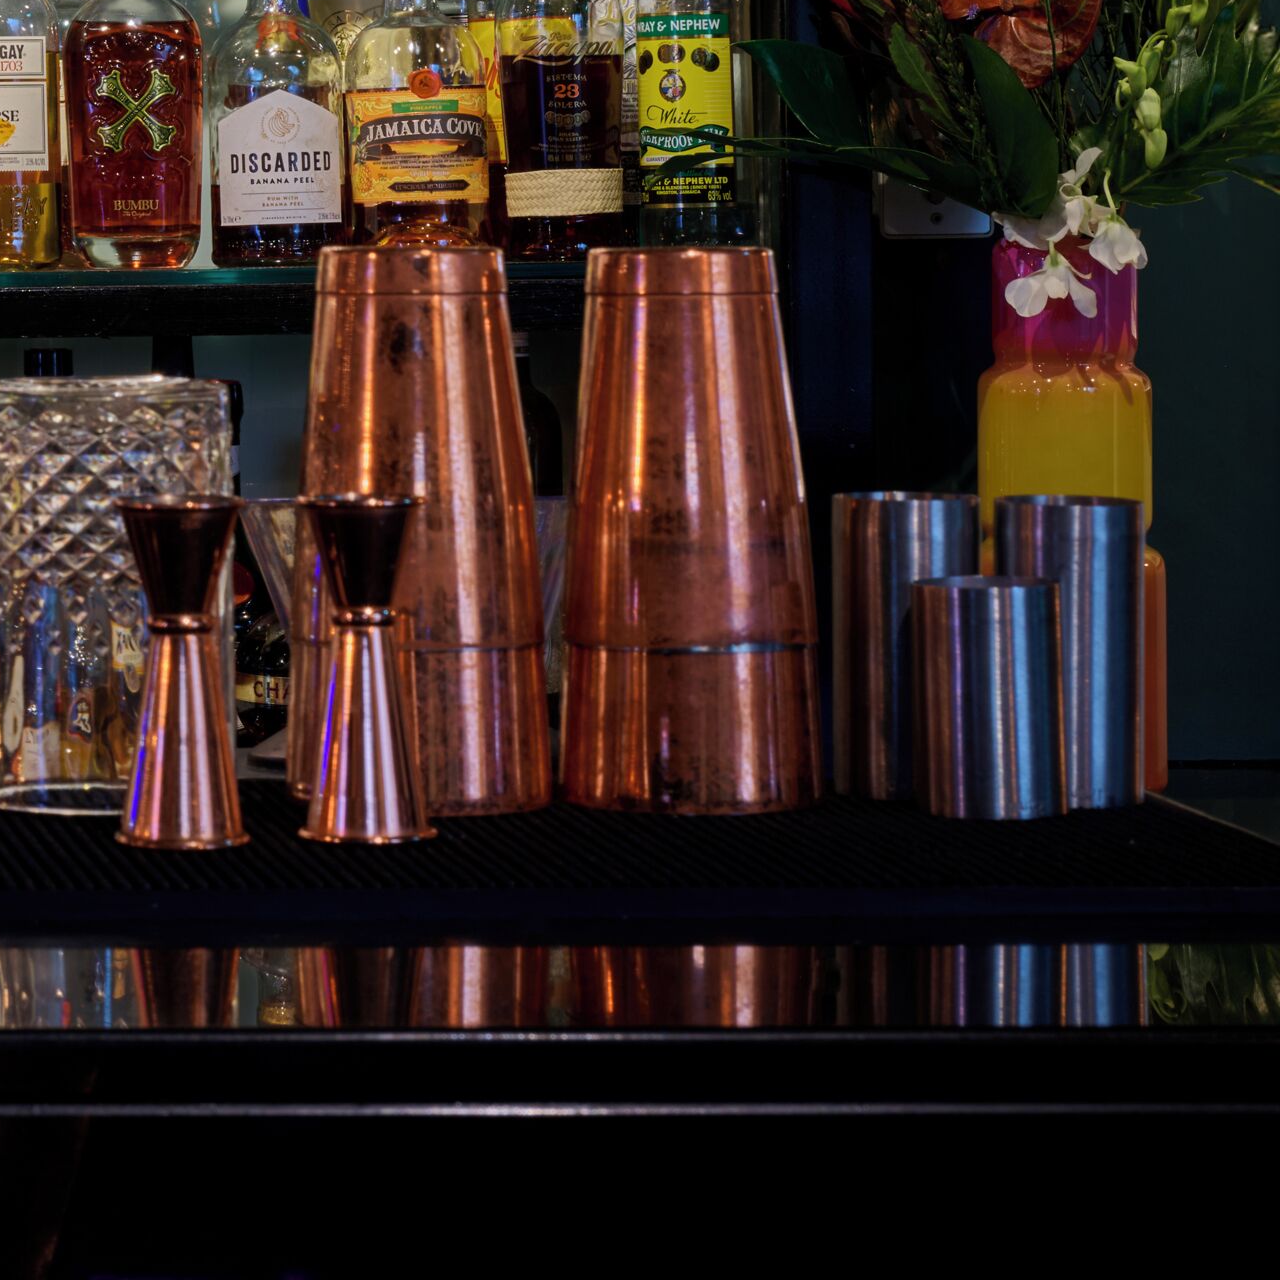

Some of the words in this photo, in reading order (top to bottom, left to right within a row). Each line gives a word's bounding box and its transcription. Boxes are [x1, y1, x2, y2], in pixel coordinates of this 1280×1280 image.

[0, 44, 25, 60] GAY
[366, 118, 442, 144] JAMAICA
[446, 118, 484, 138] COVE
[230, 150, 332, 174] DISCARDED
[250, 178, 290, 186] BANANA
[294, 177, 316, 185] PEEL
[113, 200, 160, 212] BUMBU
